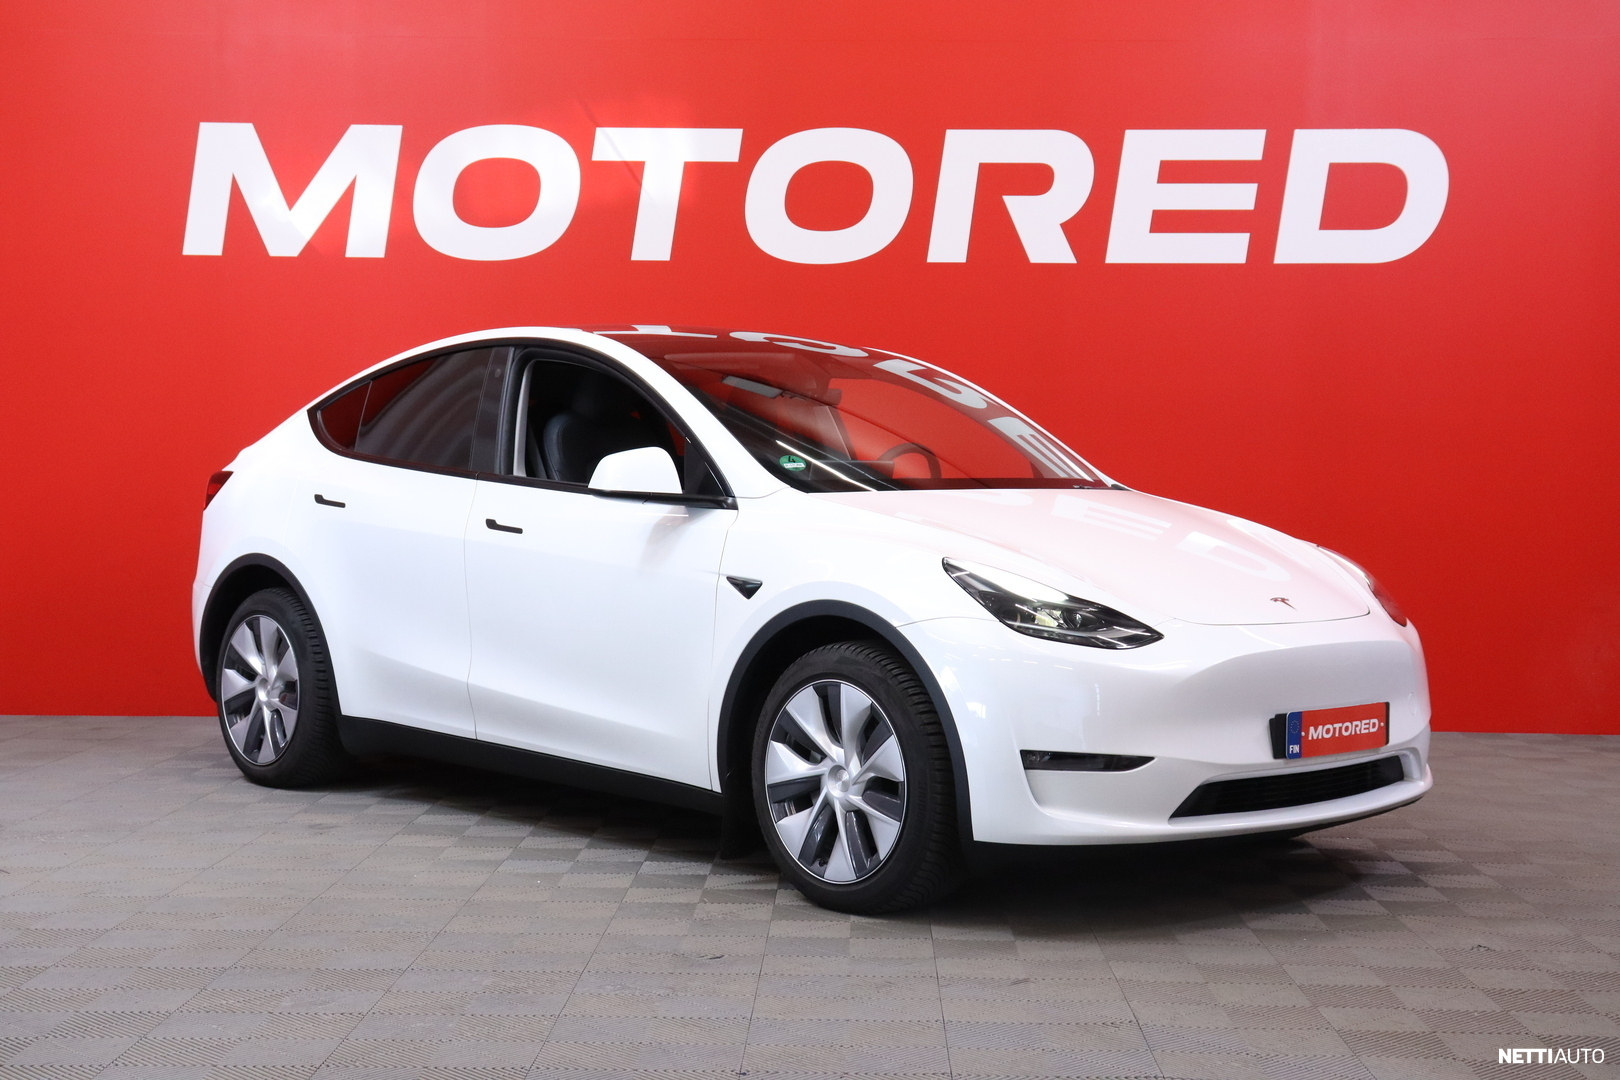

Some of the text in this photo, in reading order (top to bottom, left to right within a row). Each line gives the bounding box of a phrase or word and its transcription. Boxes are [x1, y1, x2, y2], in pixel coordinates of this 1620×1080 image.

[182, 122, 1449, 265] MOTORED
[1308, 718, 1379, 740] MOTORED
[1289, 744, 1300, 754] FIN
